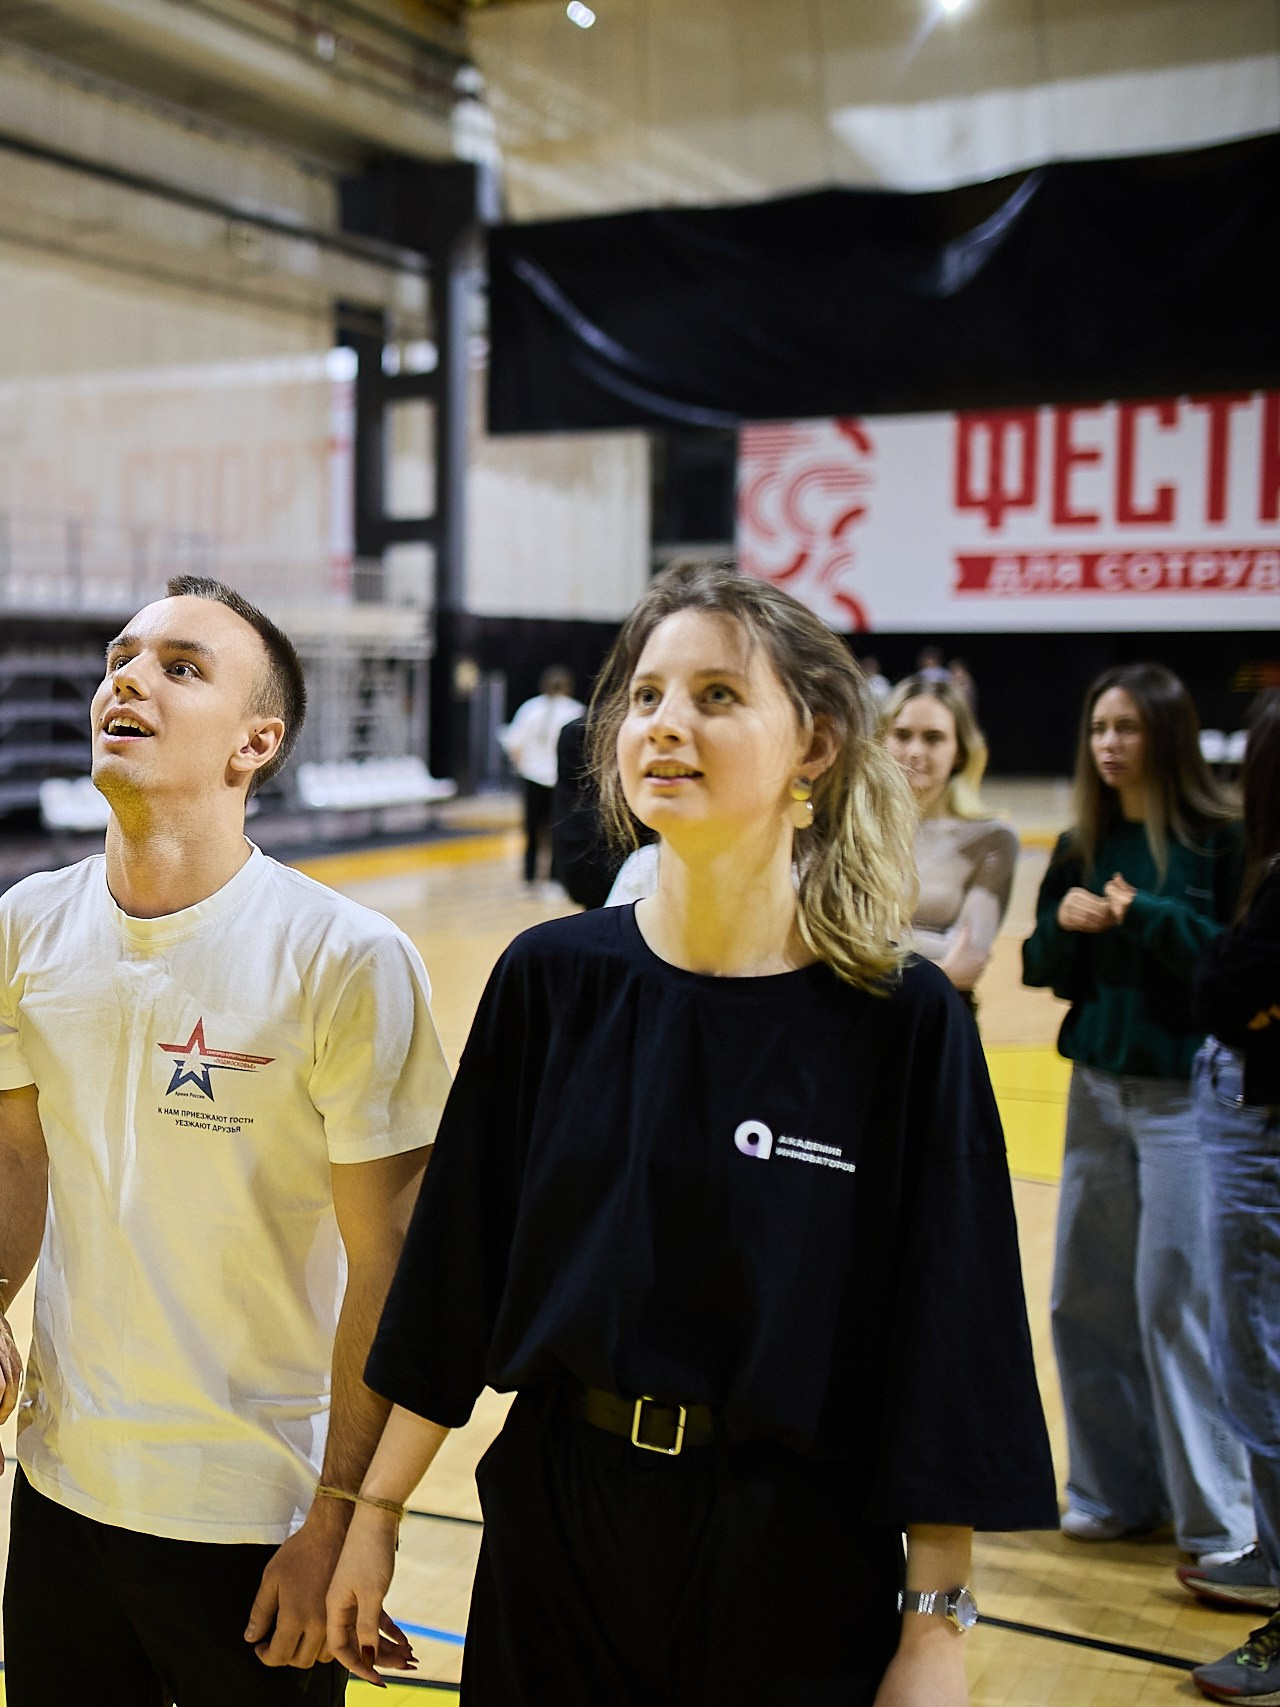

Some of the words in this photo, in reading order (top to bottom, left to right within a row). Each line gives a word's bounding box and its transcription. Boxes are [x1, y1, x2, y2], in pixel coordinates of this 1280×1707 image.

[987, 553, 1082, 594] ДЛЯ
[164, 1108, 180, 1116] НАМ
[181, 1110, 227, 1123] ПРИЕЗЖАЮТ
[229, 1116, 254, 1124] ГОСТИ
[175, 1119, 211, 1130] УЕЗЖАЮТ
[212, 1124, 241, 1134] ДРУЗЬЯ
[777, 1134, 843, 1157] АКАДЕМИЯ
[775, 1147, 857, 1173] ИННОВАТОРОВ
